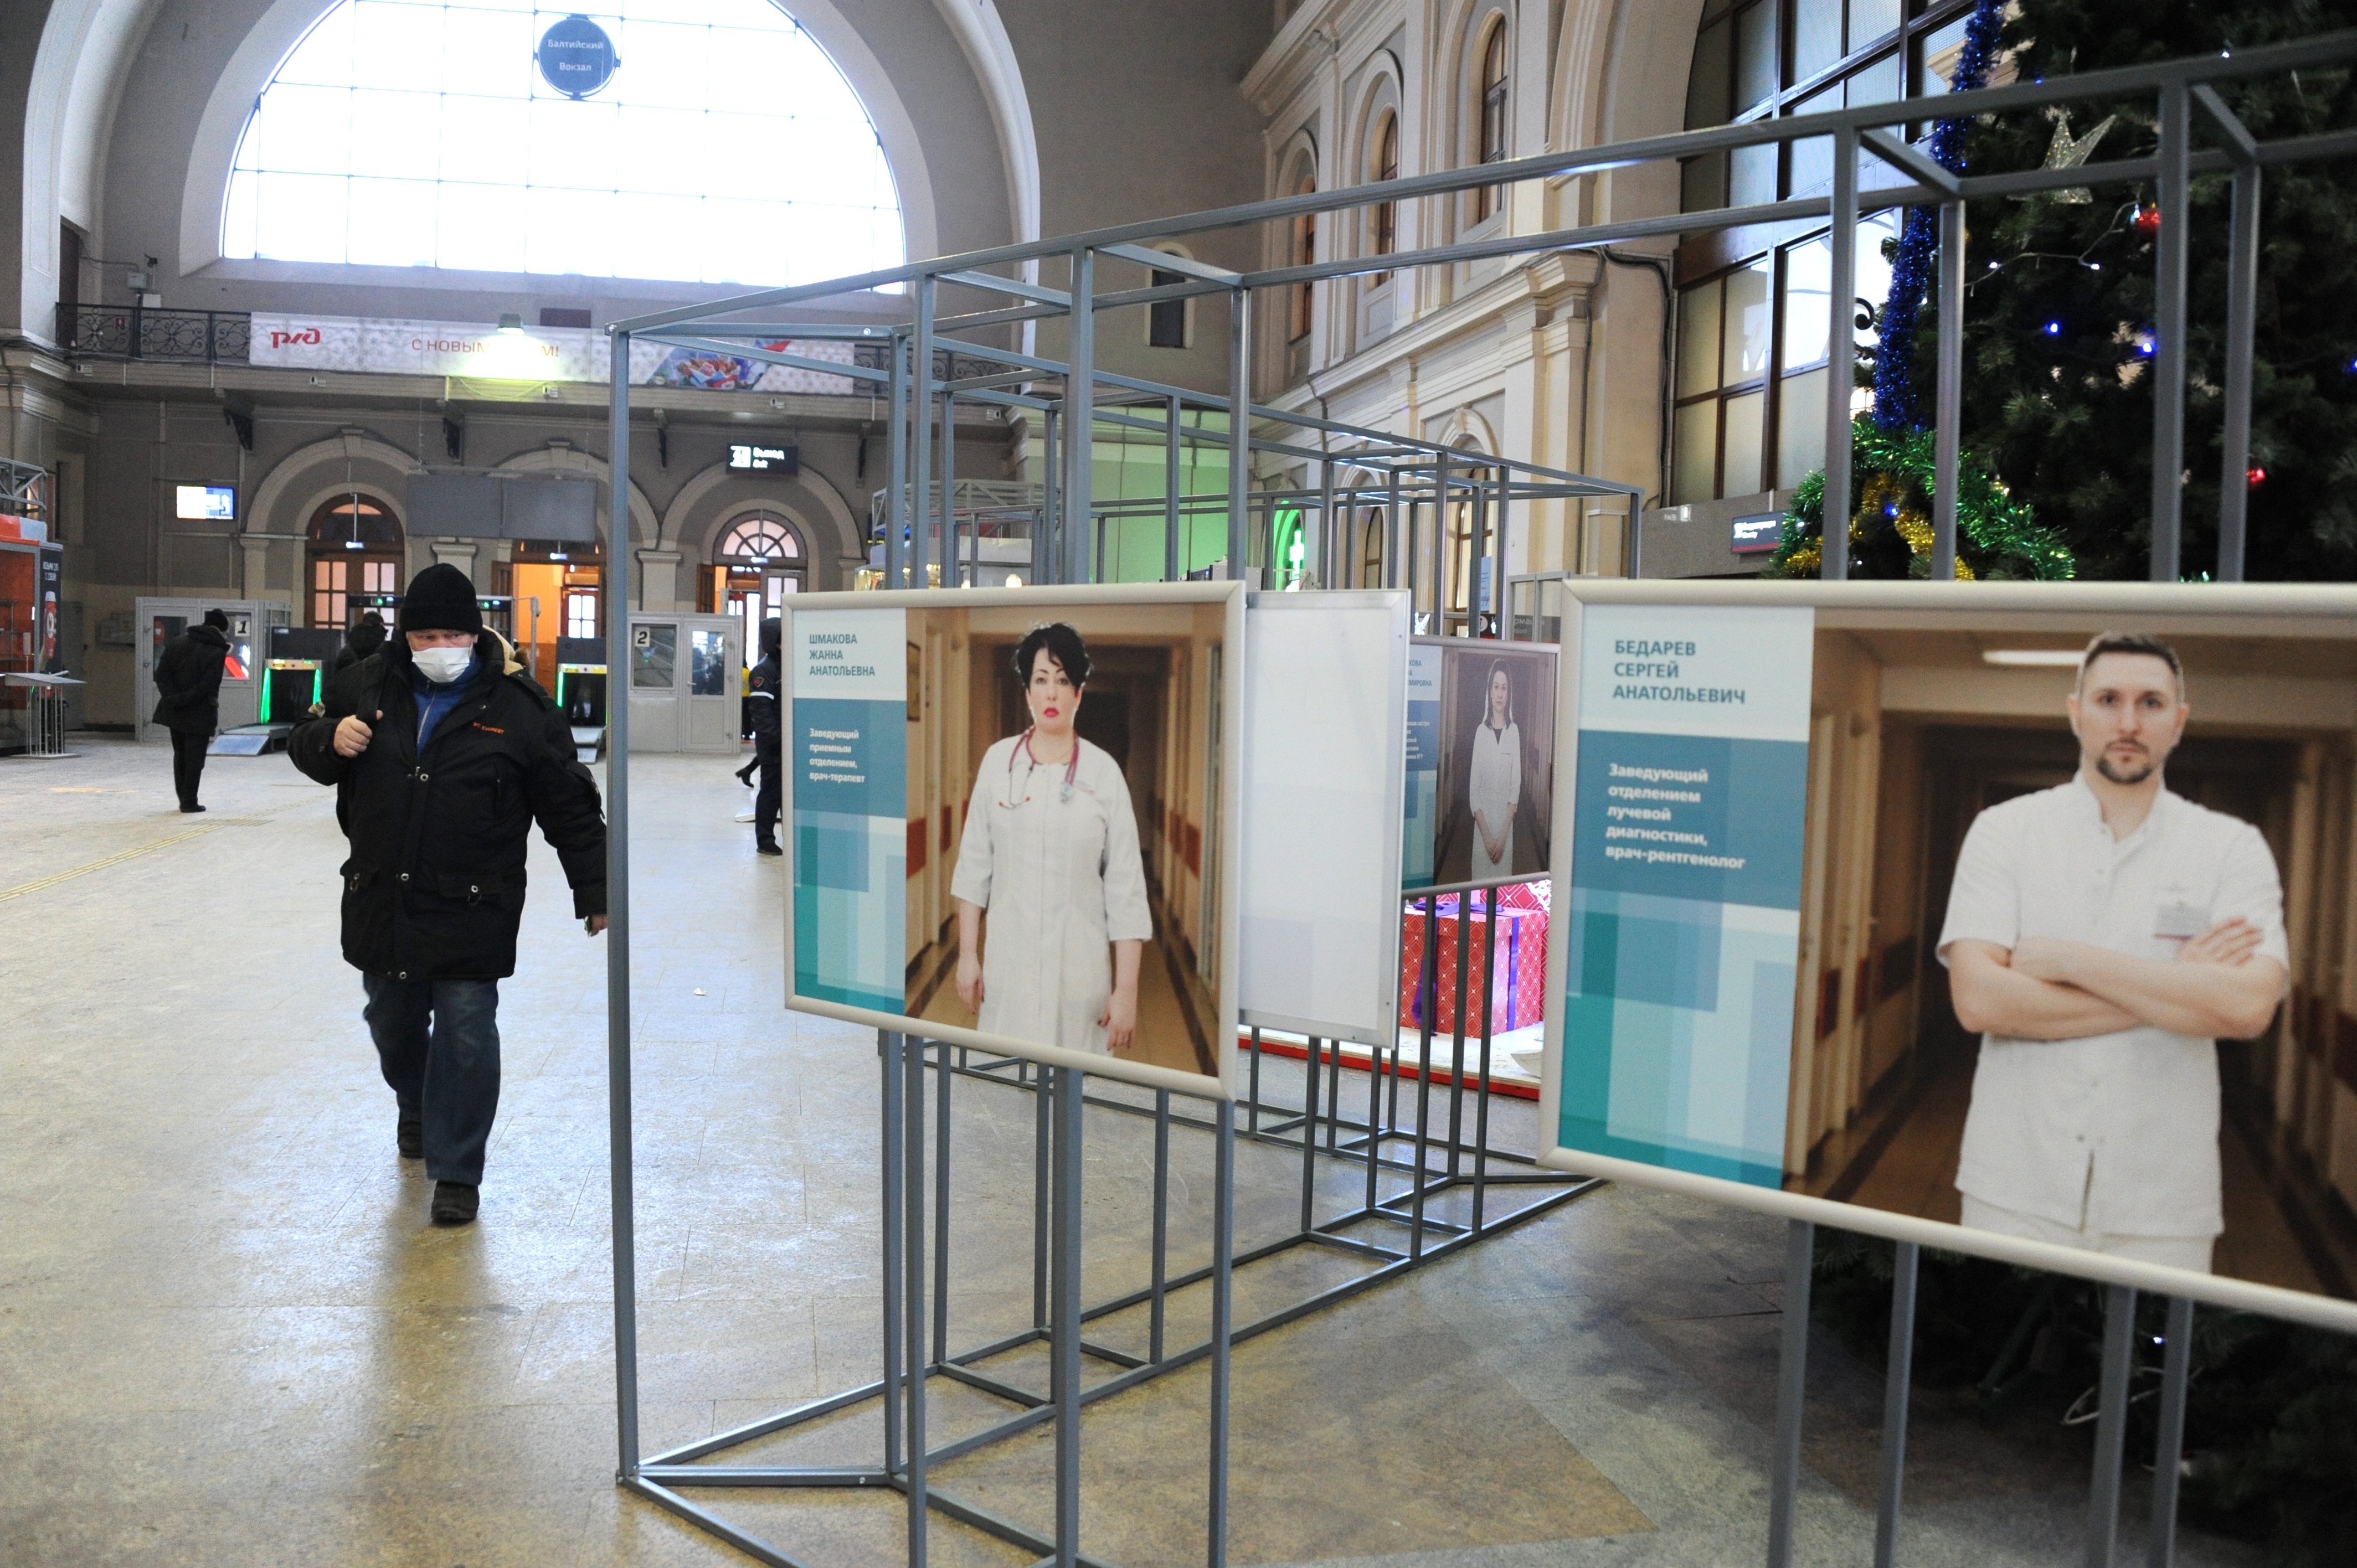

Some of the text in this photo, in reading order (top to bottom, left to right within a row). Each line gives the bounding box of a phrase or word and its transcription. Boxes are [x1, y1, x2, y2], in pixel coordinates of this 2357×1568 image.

[548, 39, 604, 49] Балтийский
[559, 62, 591, 71] Вокзал
[411, 339, 490, 353] С НОВЫМ
[238, 620, 246, 633] 1
[637, 631, 647, 644] 2
[809, 634, 857, 644] ШМАКОВА
[809, 649, 843, 659] ЖАННА
[1615, 640, 1696, 657] БЕДАРЕВ
[809, 666, 876, 675] АНАТОЛЬЕВНА
[1614, 660, 1679, 678] СЕРГЕЙ
[1613, 685, 1745, 704] АНАТОЛЬЕВИЧ
[809, 728, 860, 740] Заведующий
[809, 744, 852, 753] приемным
[809, 758, 858, 769] отделением,
[809, 772, 866, 783] врач-терапевт
[1609, 763, 1709, 783] Заведующий
[1608, 785, 1701, 803] отделением
[1607, 806, 1672, 822] лучевой
[1606, 826, 1708, 847] диагностики,
[1605, 845, 1747, 870] врач-рентгенолог
